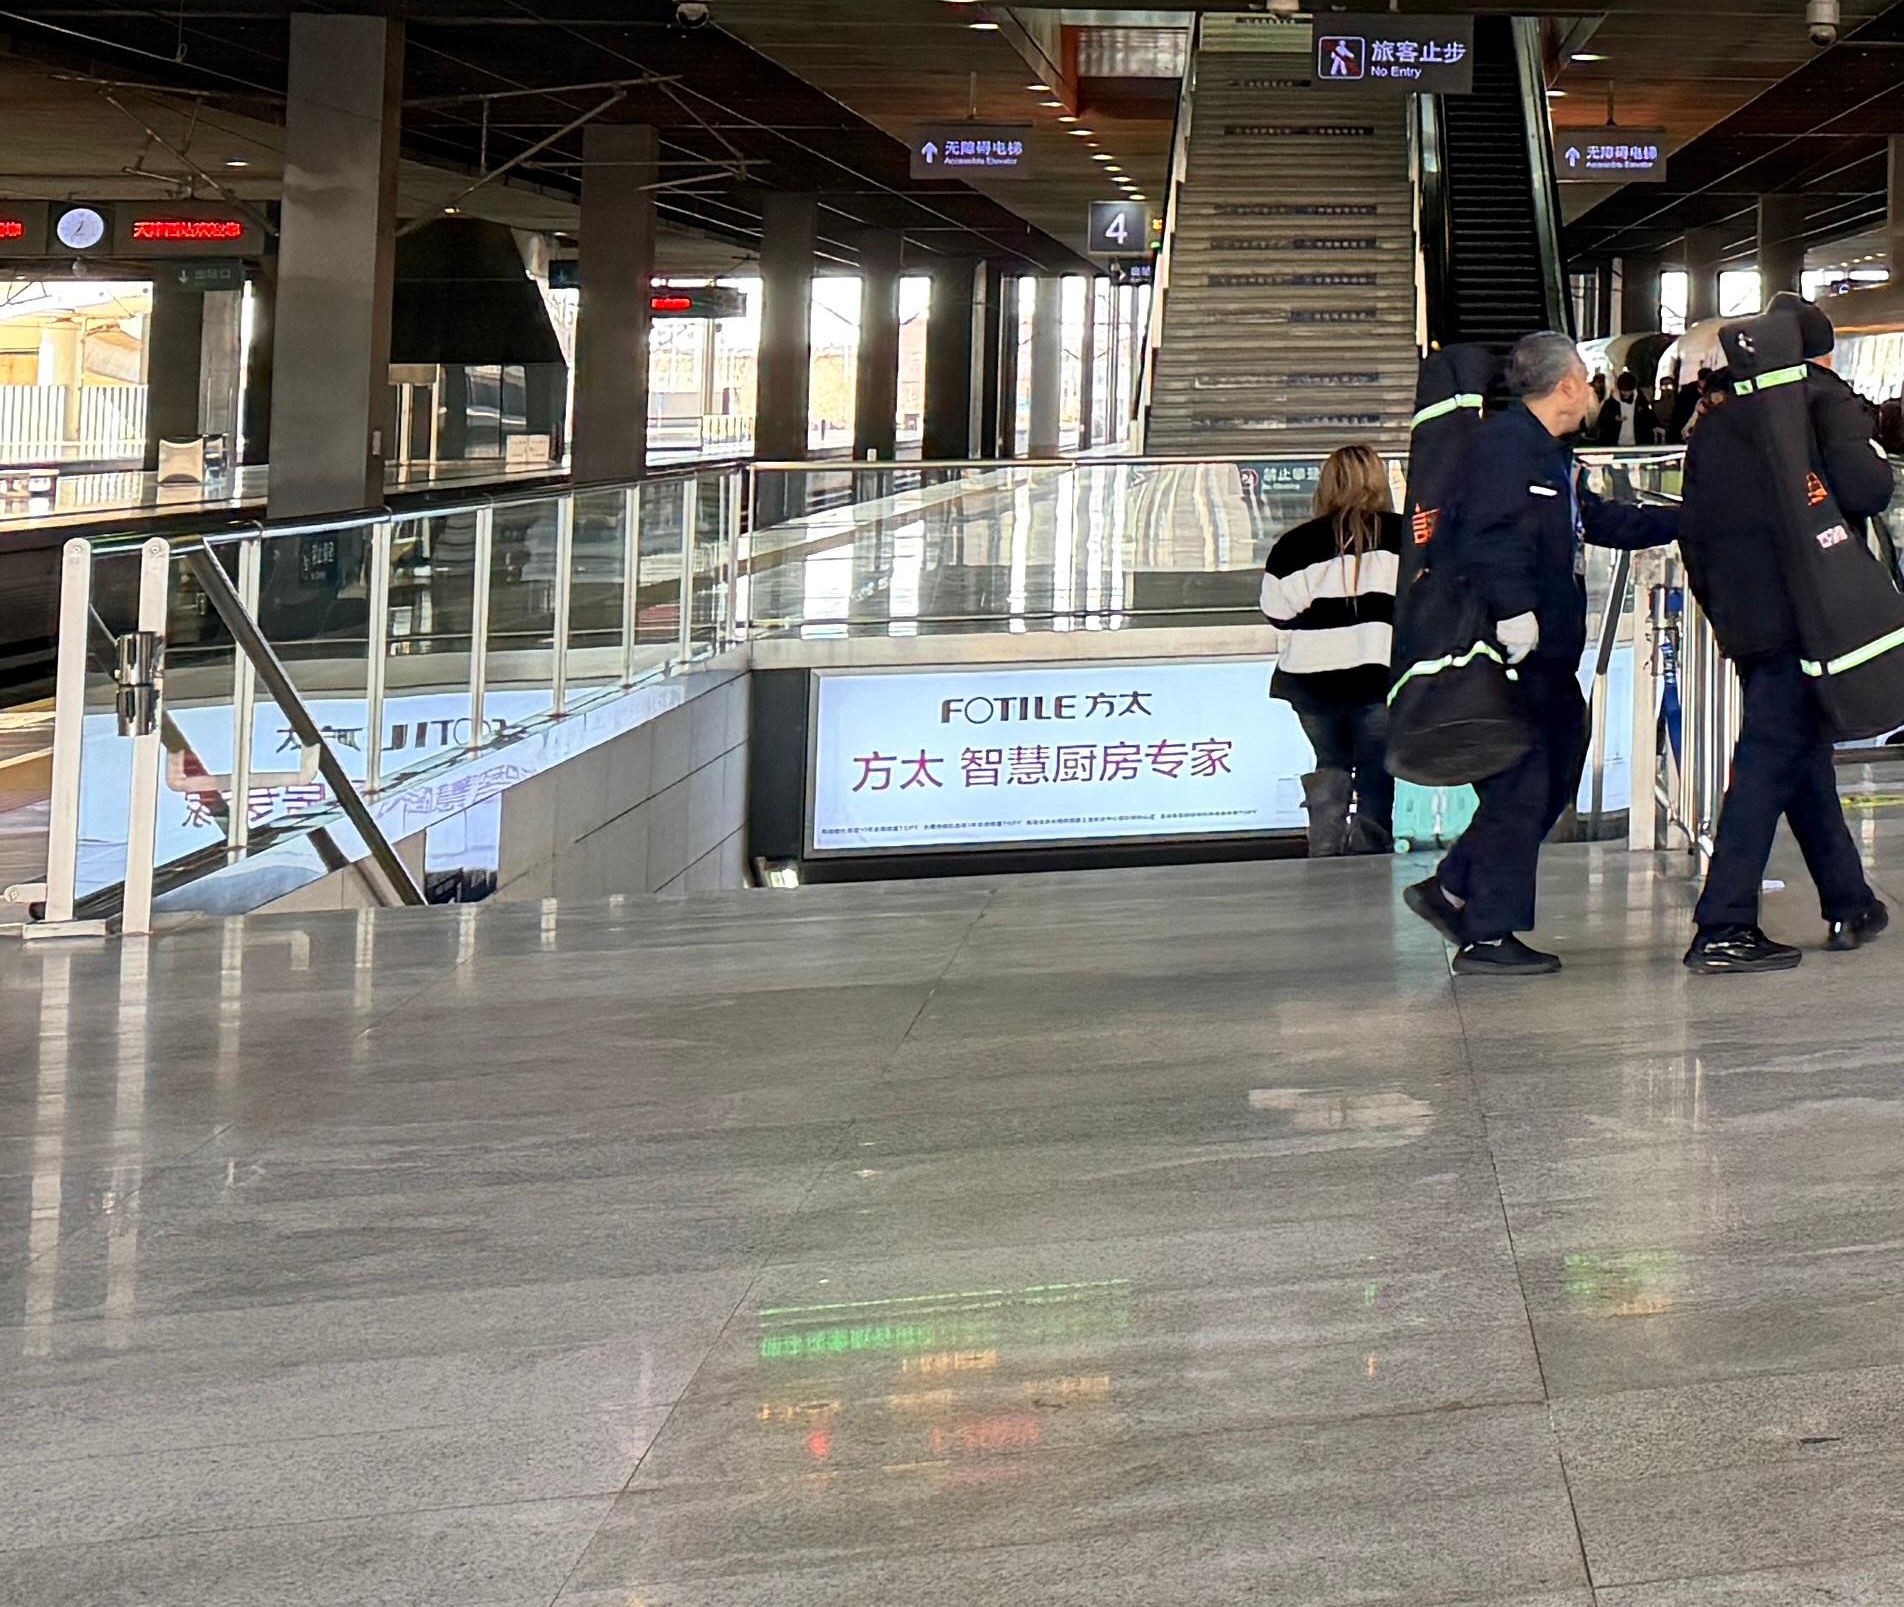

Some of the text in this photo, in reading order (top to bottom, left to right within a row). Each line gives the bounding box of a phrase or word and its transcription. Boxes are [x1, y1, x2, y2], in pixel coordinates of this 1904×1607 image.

[1371, 40, 1467, 64] 旅客止步
[1371, 66, 1422, 79] No Entry
[1105, 213, 1128, 244] 4
[941, 691, 1153, 725] FOTILE 方太
[851, 737, 1233, 792] 方太 智慧厨房专家
